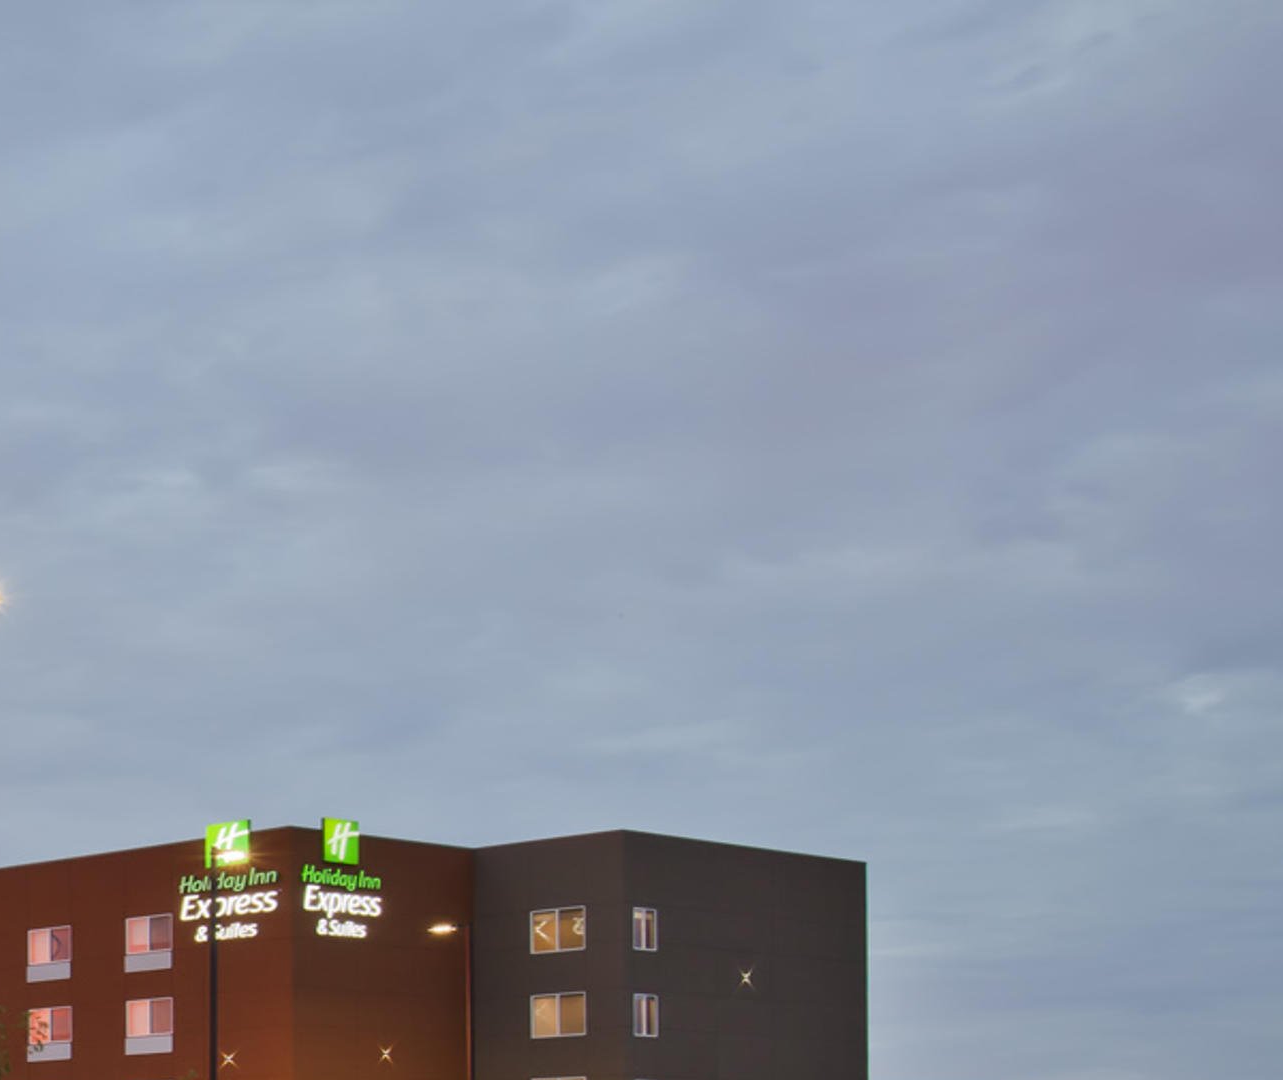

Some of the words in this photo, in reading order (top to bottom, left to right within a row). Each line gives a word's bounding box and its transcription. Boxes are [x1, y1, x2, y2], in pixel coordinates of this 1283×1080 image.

[248, 867, 278, 886] Inn
[302, 864, 357, 891] Holiday
[358, 871, 381, 890] Inn
[303, 884, 382, 918] Express
[194, 925, 208, 942] &
[316, 919, 329, 936] &
[329, 920, 367, 938] Suites
